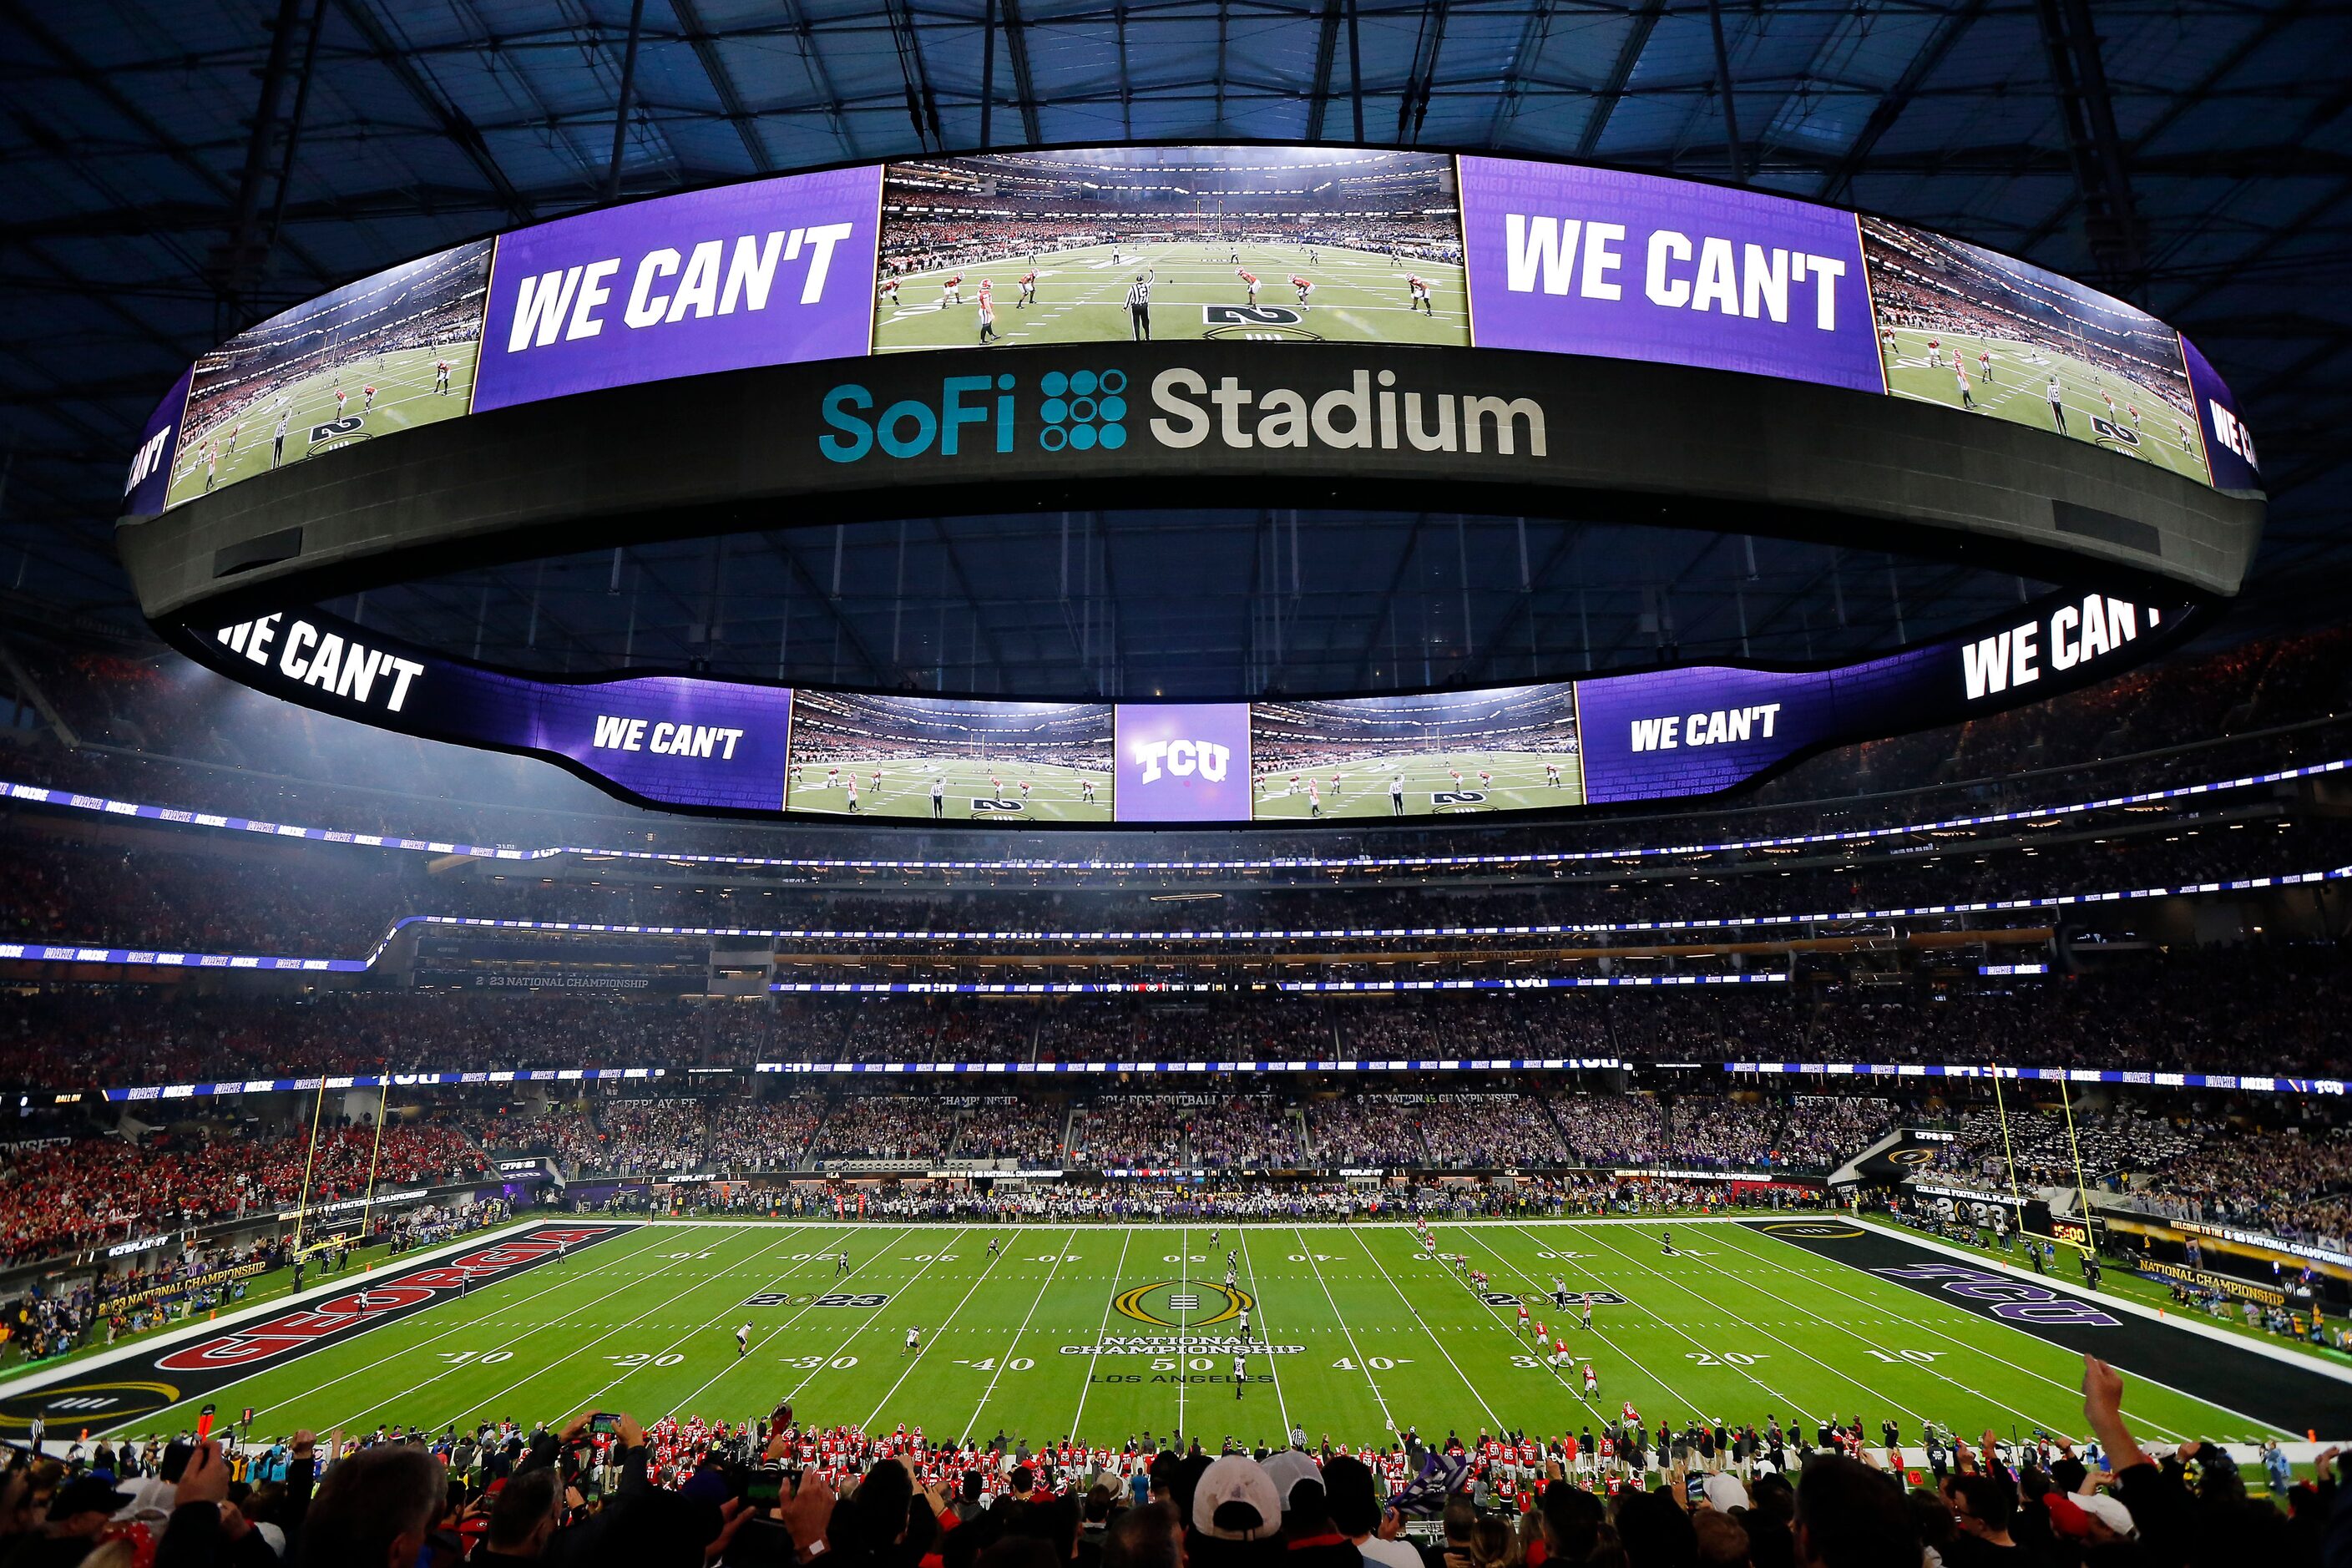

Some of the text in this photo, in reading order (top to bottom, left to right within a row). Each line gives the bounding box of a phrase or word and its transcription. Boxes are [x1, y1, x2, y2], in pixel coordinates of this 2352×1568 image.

[1505, 213, 1846, 331] WE CAN'T
[508, 221, 853, 354] WE CAN'T
[819, 367, 1548, 463] SoFi Stadium
[2209, 398, 2242, 458] WE
[1961, 589, 2161, 701] WE CAN
[280, 616, 424, 712] CAN'T
[1630, 702, 1781, 752] WE CAN'T
[592, 714, 743, 761] WE CAN'T
[1133, 739, 1231, 786] TCU
[12, 784, 49, 802] NOISE
[70, 794, 139, 816] MAKE NOISE
[159, 808, 229, 828] MAKE NOISE
[246, 820, 308, 838] MAKE NOISE
[43, 947, 109, 962] MAKE NOISE
[126, 952, 185, 965] MAKE NOISE
[200, 955, 260, 969] MAKE NOISE
[275, 959, 301, 969] MAKE
[506, 977, 649, 989] NATIONAL CHAMPIONSHIP
[461, 1070, 515, 1083] MAKE NOISE
[530, 1070, 555, 1080] MAKE
[598, 1069, 622, 1079] MAKE
[2122, 1071, 2185, 1086] MAKE NOISE
[213, 1080, 276, 1095] MAKE NOISE
[294, 1075, 355, 1090] MAKE NOISE
[2205, 1075, 2275, 1092] MAKE NOISE
[2314, 1080, 2344, 1095] TCU
[55, 1093, 81, 1104] BALL ON
[127, 1085, 195, 1100] MAKE NOISE
[1915, 1184, 1950, 1197] COLLEGE
[1950, 1188, 1991, 1202] FOOTBALL
[2170, 1220, 2201, 1234] WELCOME
[2211, 1227, 2223, 1237] THE
[2247, 1233, 2290, 1252] NATIONAL
[128, 1283, 184, 1307] NATIONAL
[185, 1262, 266, 1290] CHAMPIONSHIP
[2139, 1259, 2195, 1282] NATIONAL
[2196, 1272, 2285, 1307] CHAMPIONSHIP
[154, 1227, 619, 1371] GEORGIA
[1869, 1263, 2124, 1327] TCU
[1102, 1335, 1266, 1346] NATIONAL
[443, 1350, 515, 1365] 10
[1058, 1345, 1308, 1355] CHAMPIONSHIP
[1863, 1349, 1936, 1363] 10
[612, 1353, 685, 1368] 20
[791, 1355, 858, 1370] 30
[971, 1357, 1036, 1372] 40
[1150, 1358, 1215, 1372] 50
[1331, 1357, 1395, 1371] 40
[1510, 1354, 1576, 1369] 30
[1684, 1352, 1755, 1367] 20
[1090, 1374, 1275, 1384] LOS ANGELES
